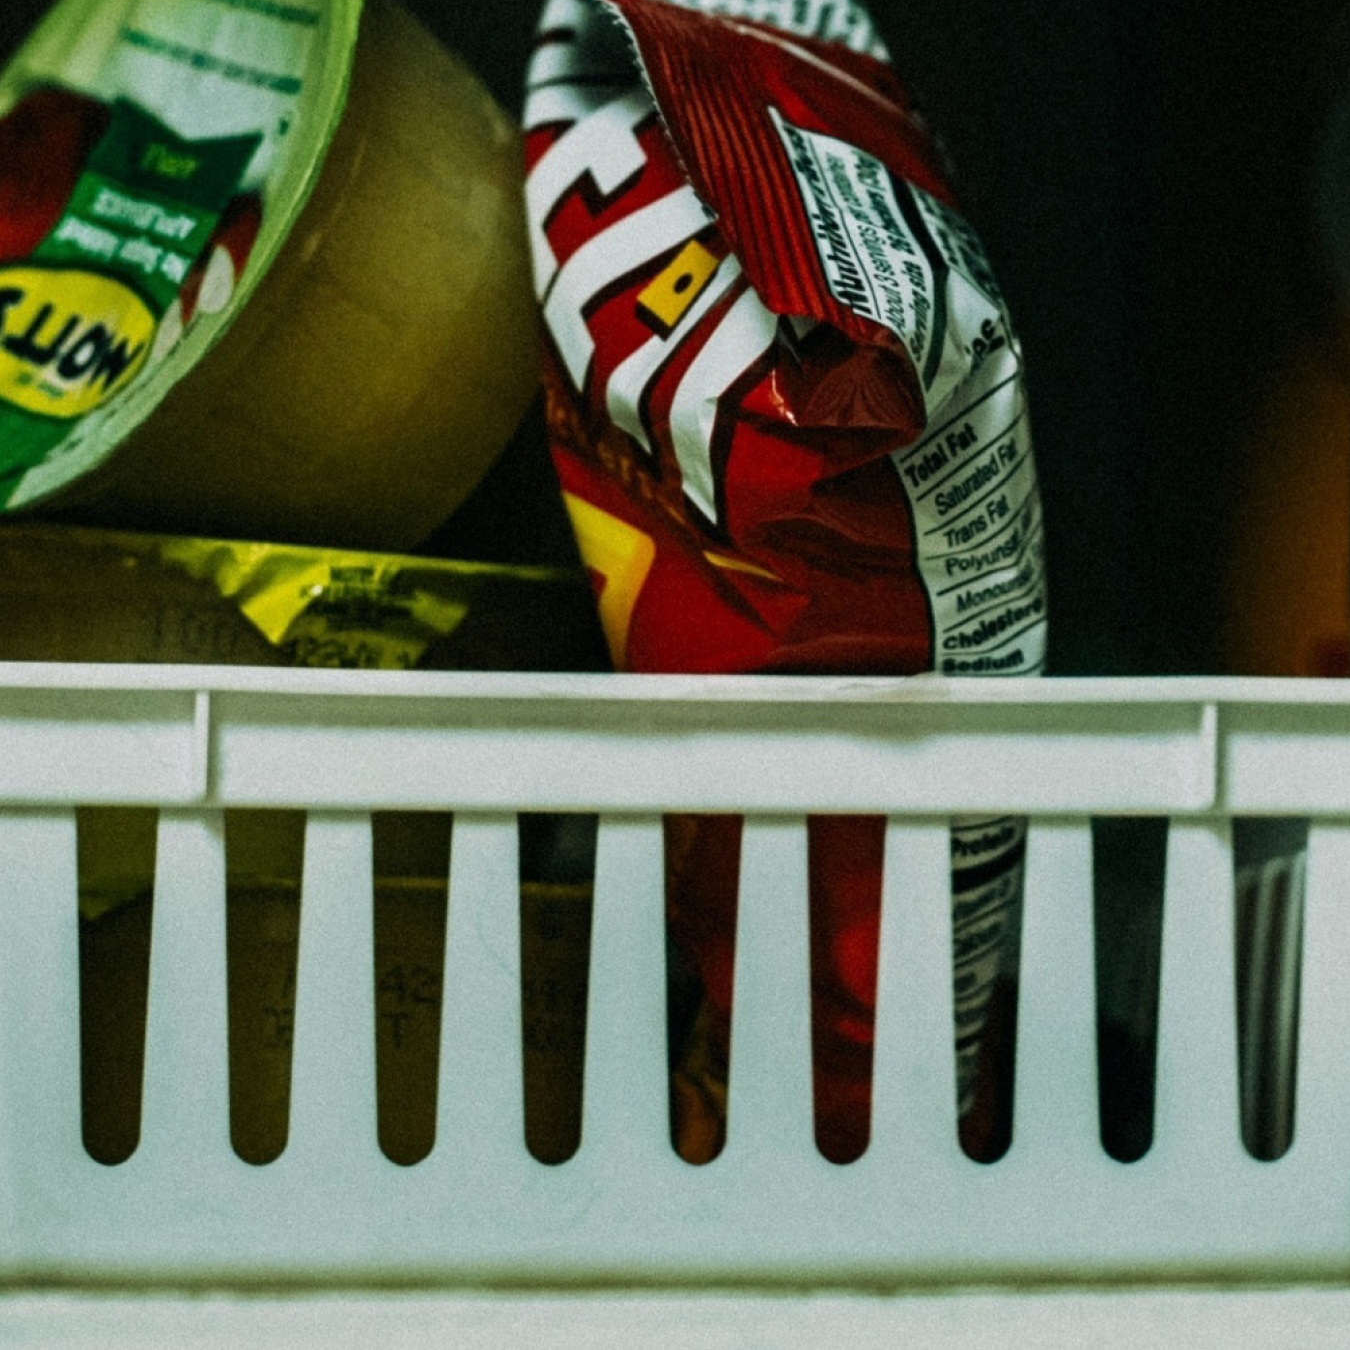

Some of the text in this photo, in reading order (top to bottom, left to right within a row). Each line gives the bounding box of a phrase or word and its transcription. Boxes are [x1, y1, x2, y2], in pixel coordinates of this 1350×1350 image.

[903, 422, 979, 488] Total Fat
[934, 452, 1001, 516] Saturated
[942, 515, 988, 548] Trans
